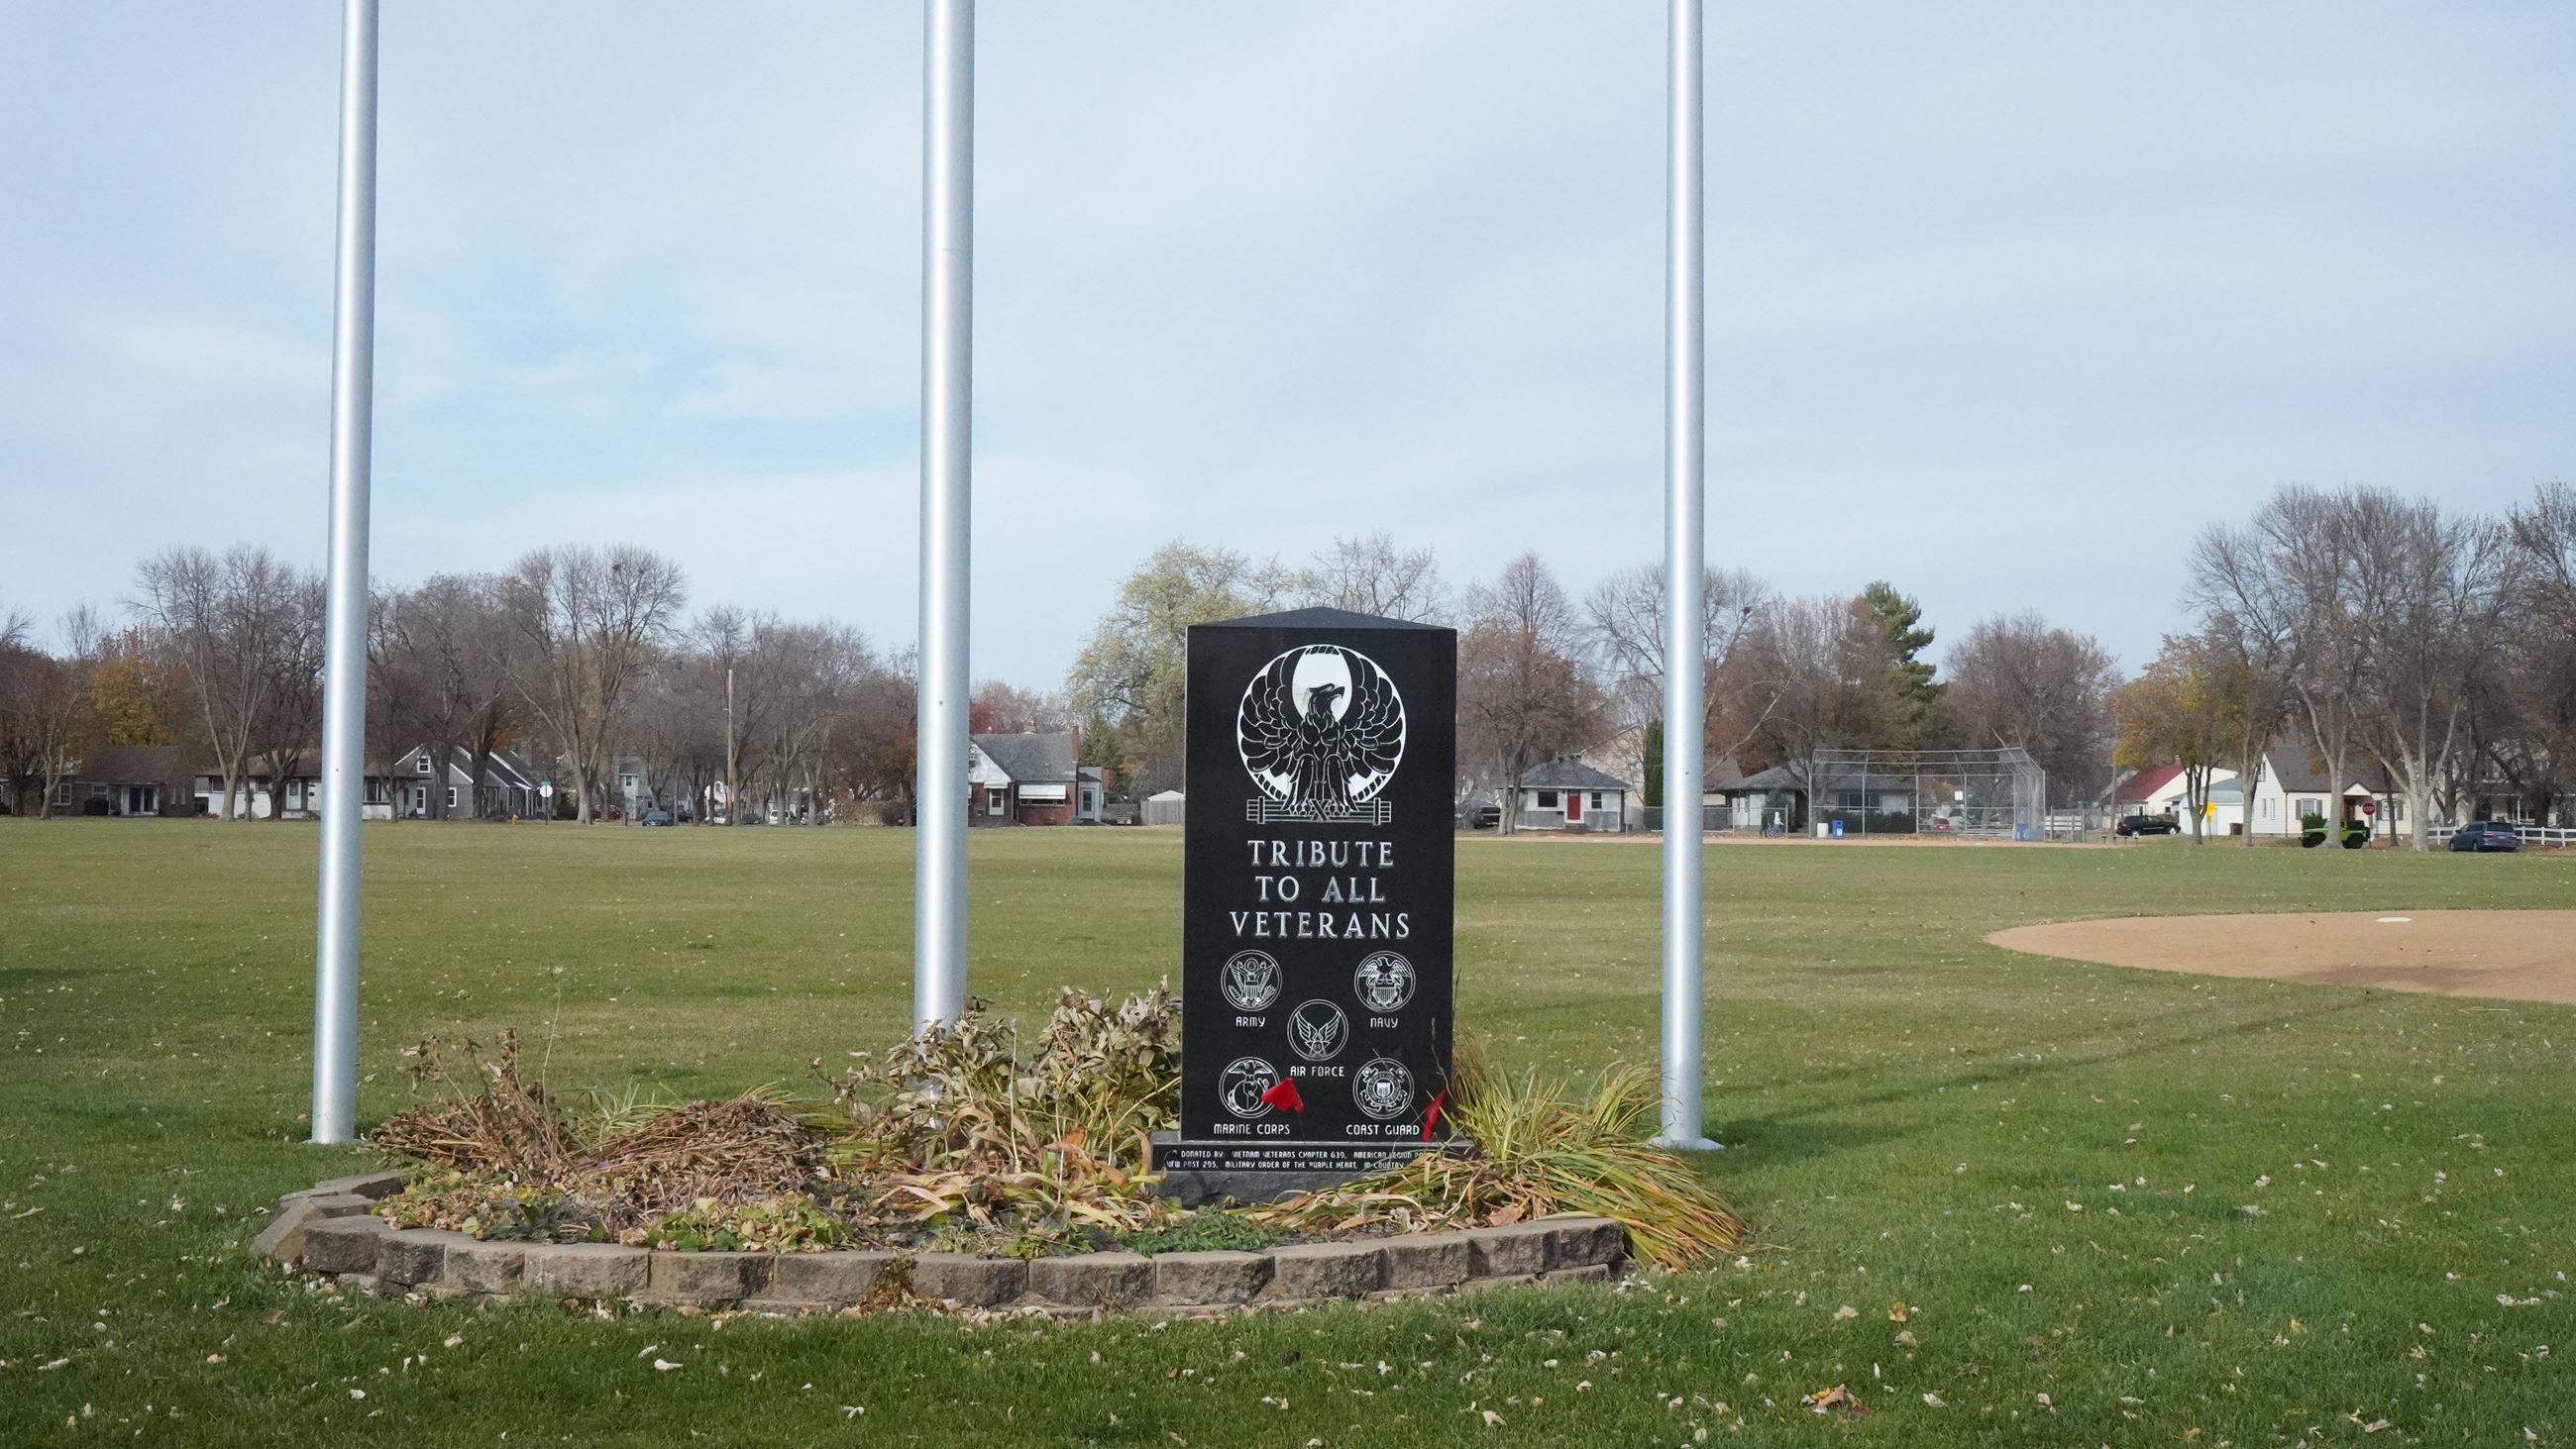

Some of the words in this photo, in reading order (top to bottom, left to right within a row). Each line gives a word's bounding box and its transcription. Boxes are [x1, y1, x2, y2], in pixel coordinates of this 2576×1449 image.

[1246, 840, 1395, 869] TRIBUTE
[1254, 875, 1300, 902] TO
[1321, 876, 1386, 903] ALL
[1229, 910, 1411, 939] VETERANS
[1235, 1016, 1266, 1028] ARMY
[1370, 1017, 1399, 1028] NAVY
[1290, 1066, 1306, 1077] AIR
[1311, 1066, 1345, 1078] FORCE
[1213, 1123, 1251, 1134] MARINE
[1256, 1123, 1291, 1135] CORPS
[1345, 1124, 1379, 1135] COAST
[1385, 1124, 1420, 1135] GUARD
